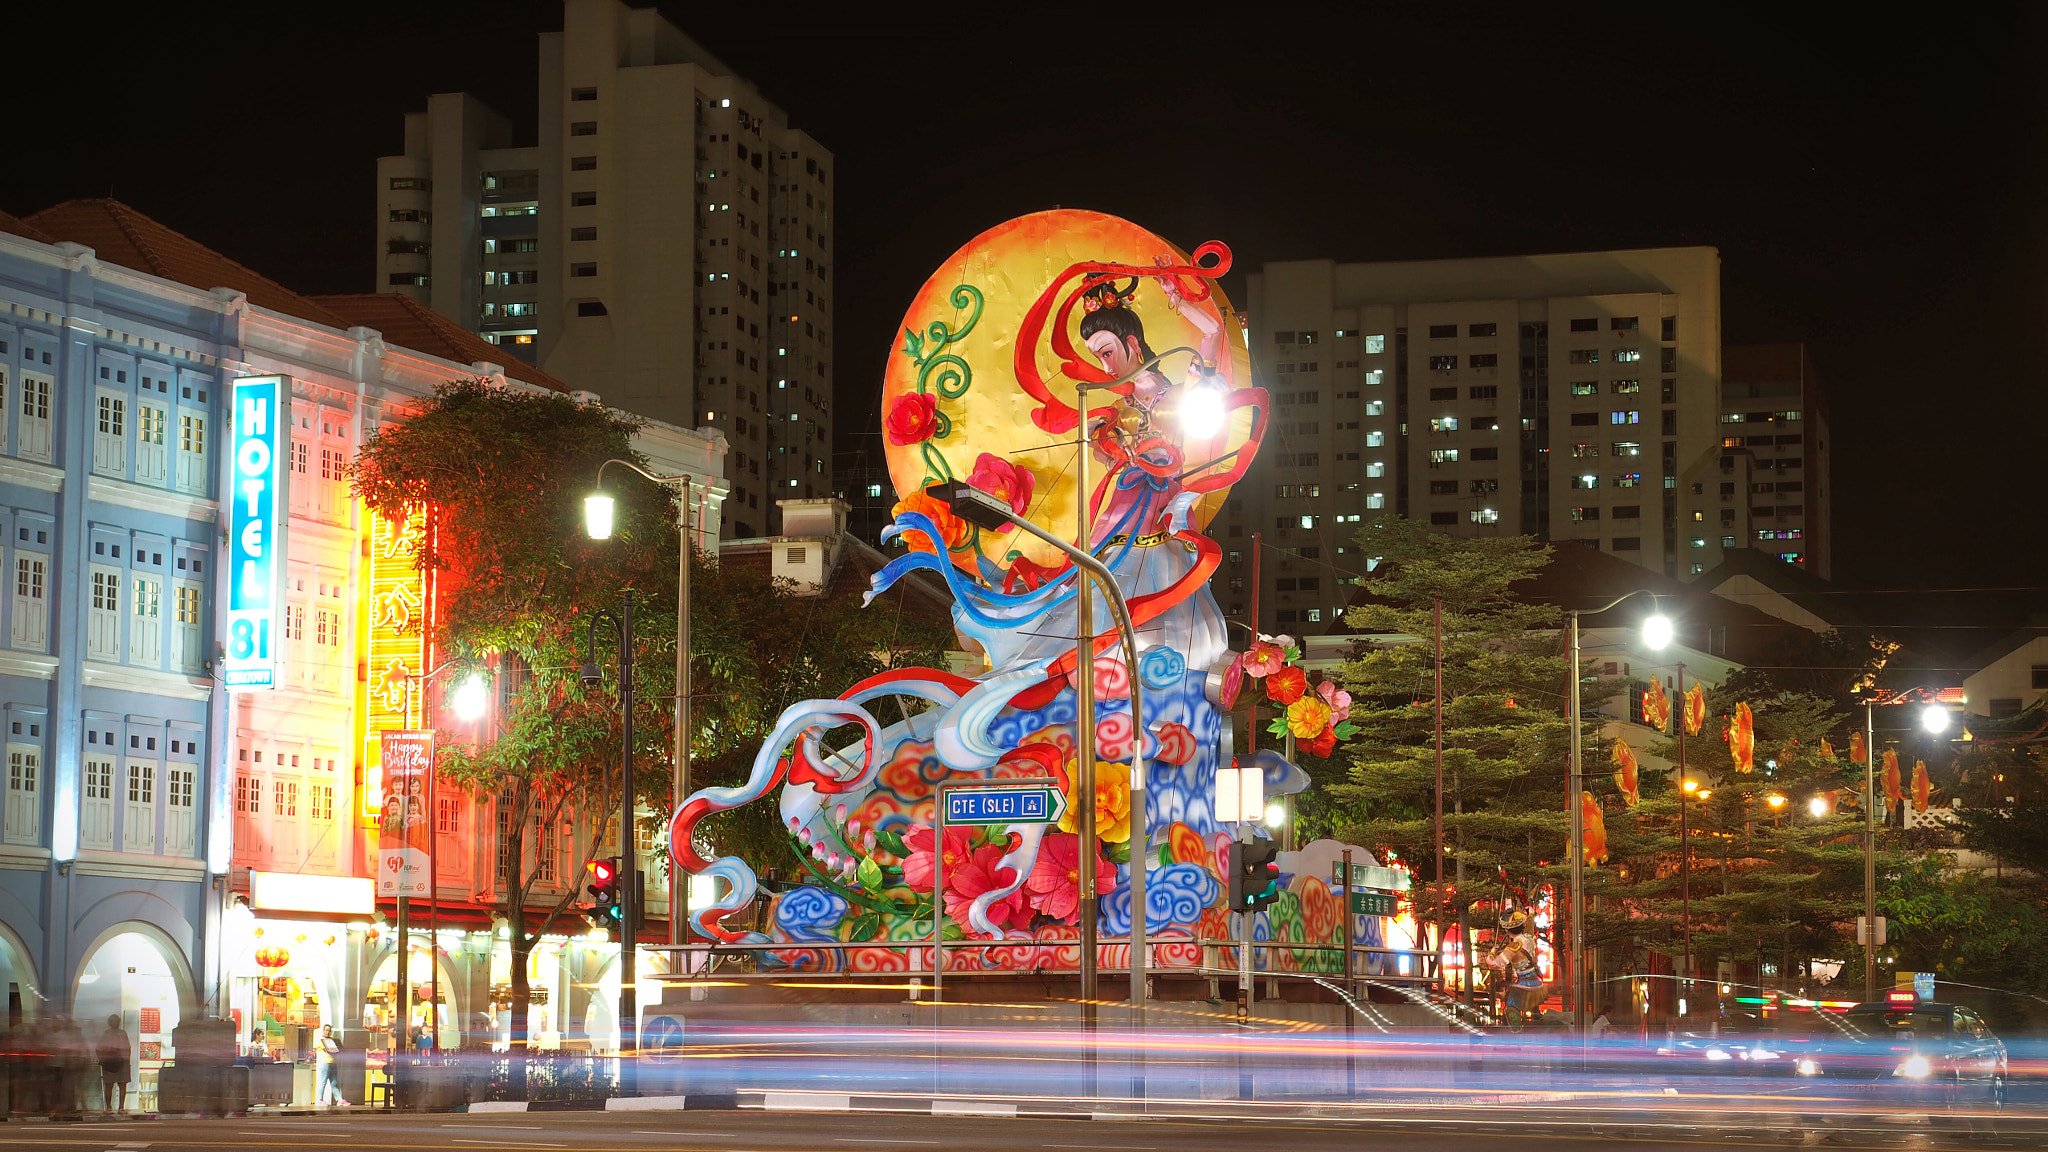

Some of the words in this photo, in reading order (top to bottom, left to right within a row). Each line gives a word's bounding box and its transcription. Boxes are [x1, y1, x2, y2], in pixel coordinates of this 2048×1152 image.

[237, 397, 271, 599] HOTEL
[229, 617, 269, 661] 81
[389, 740, 425, 756] Happy
[383, 751, 430, 769] Birthday
[952, 799, 976, 814] CTE
[982, 797, 1015, 815] (SLE)
[1353, 866, 1362, 880] Eu
[1089, 878, 1095, 900] 41
[1890, 993, 1914, 1001] HIRED
